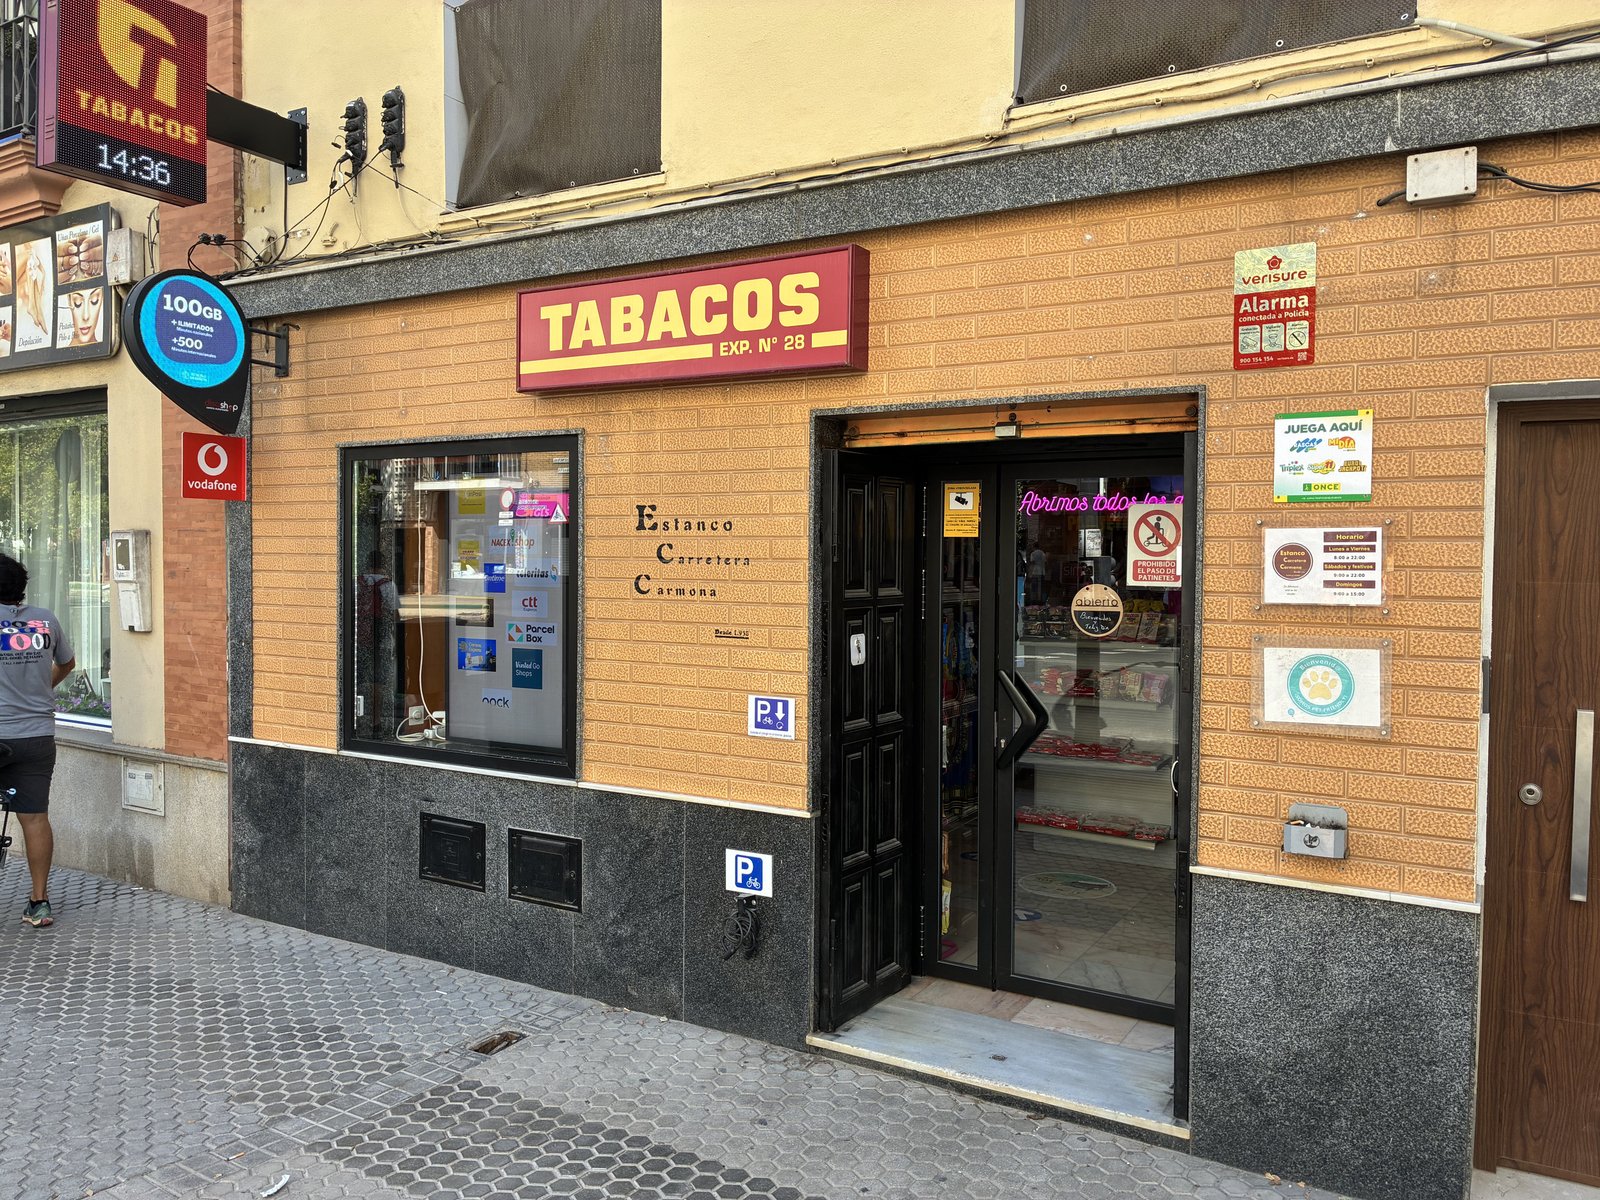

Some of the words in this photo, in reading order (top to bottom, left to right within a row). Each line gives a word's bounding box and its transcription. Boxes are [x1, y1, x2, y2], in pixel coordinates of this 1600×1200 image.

[76, 90, 199, 145] TABACOS
[98, 144, 171, 186] 14:36
[1241, 269, 1308, 286] verisure
[163, 293, 223, 321] 100GB
[540, 271, 820, 351] TABACOS
[1239, 294, 1309, 314] Alarma
[1238, 312, 1276, 323] conectada
[177, 320, 214, 333] ILIMITADOS
[171, 336, 203, 350] +500
[719, 338, 752, 357] EXP.
[783, 335, 805, 351] 28
[1284, 423, 1327, 434] JUEGA
[1329, 419, 1363, 432] AQUÍ
[188, 479, 237, 491] vodafone
[1018, 490, 1089, 516] Abrimos
[1092, 491, 1137, 512] todos
[635, 504, 733, 532] Estanco
[656, 543, 750, 566] Carretera
[1146, 567, 1166, 575] PASO
[633, 574, 717, 597] Carmona
[521, 596, 538, 608] ctt
[1075, 596, 1119, 607] abierto
[0, 620, 50, 628] OOST
[526, 624, 555, 634] Parcel
[526, 633, 543, 643] Box
[515, 669, 533, 678] Shops
[532, 662, 541, 670] Go
[757, 700, 771, 723] P
[736, 855, 754, 884] P
